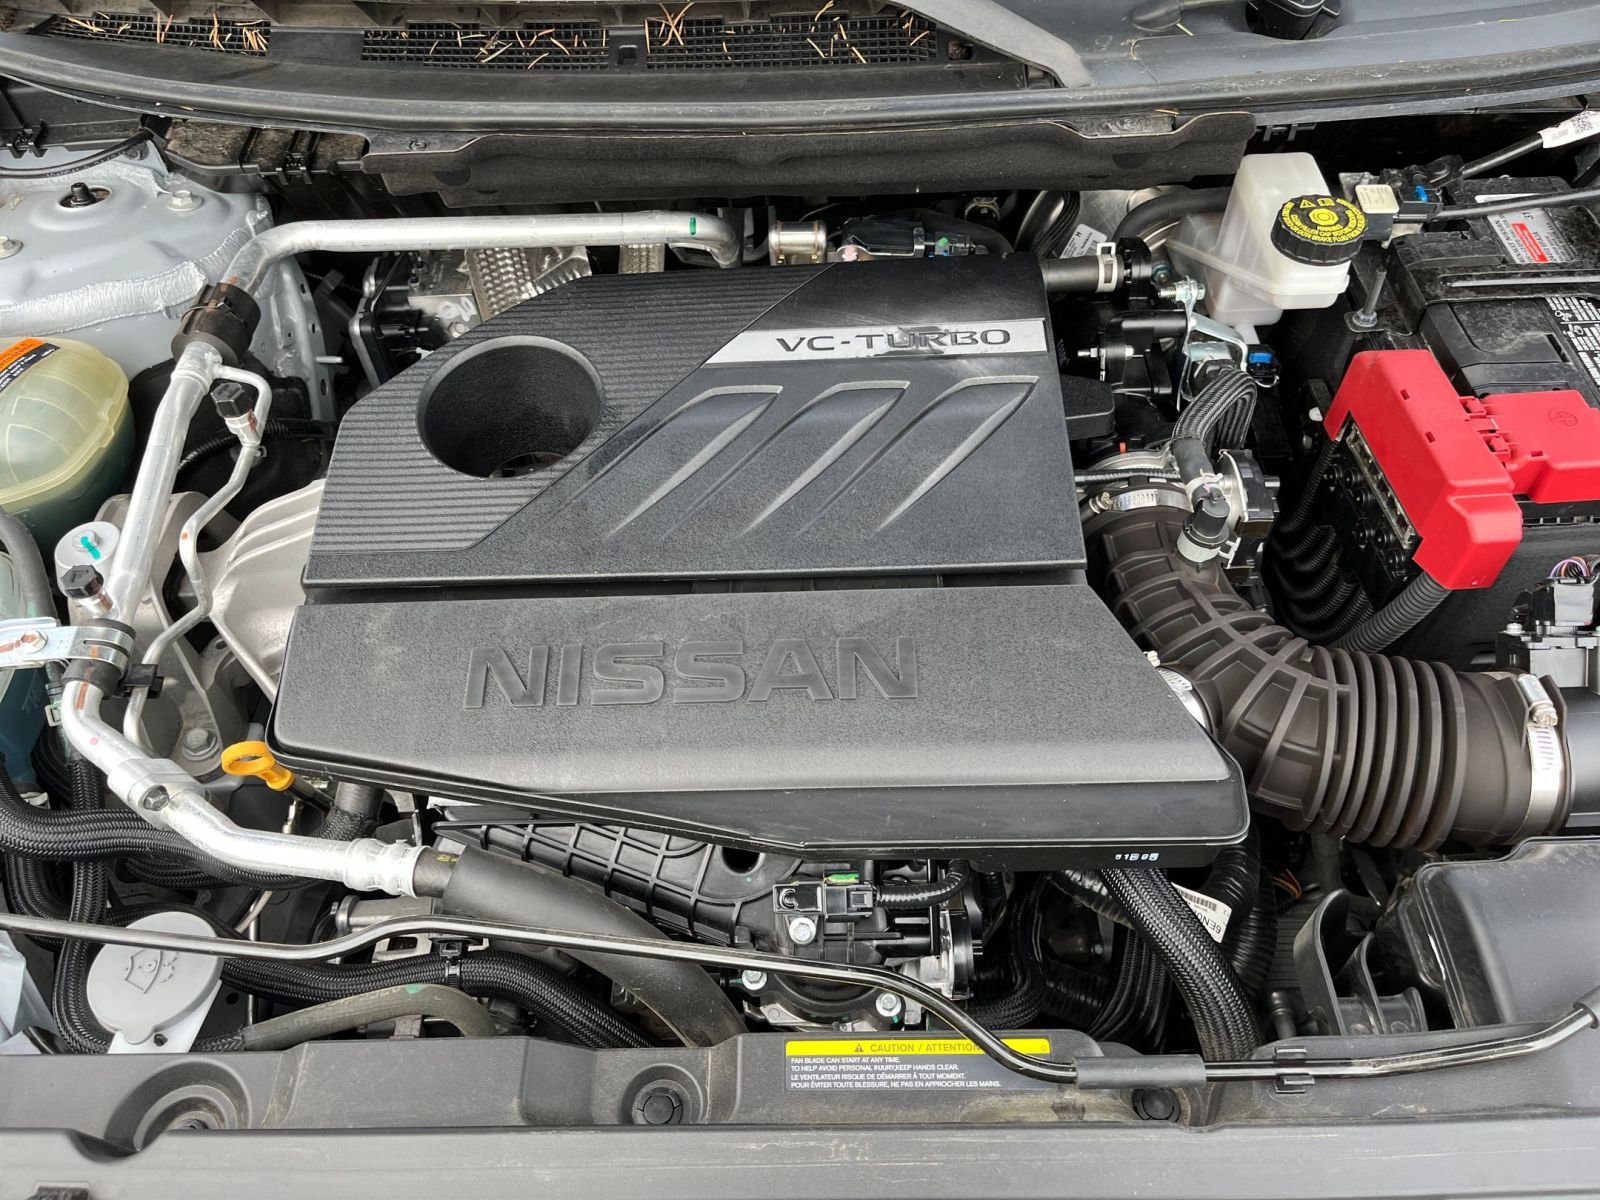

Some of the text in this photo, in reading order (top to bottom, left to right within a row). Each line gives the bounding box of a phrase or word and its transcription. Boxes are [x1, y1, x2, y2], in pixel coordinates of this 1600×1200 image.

[462, 636, 918, 710] NISSAN
[870, 1044, 914, 1052] CAUTION
[810, 1080, 832, 1088] ÉVITER
